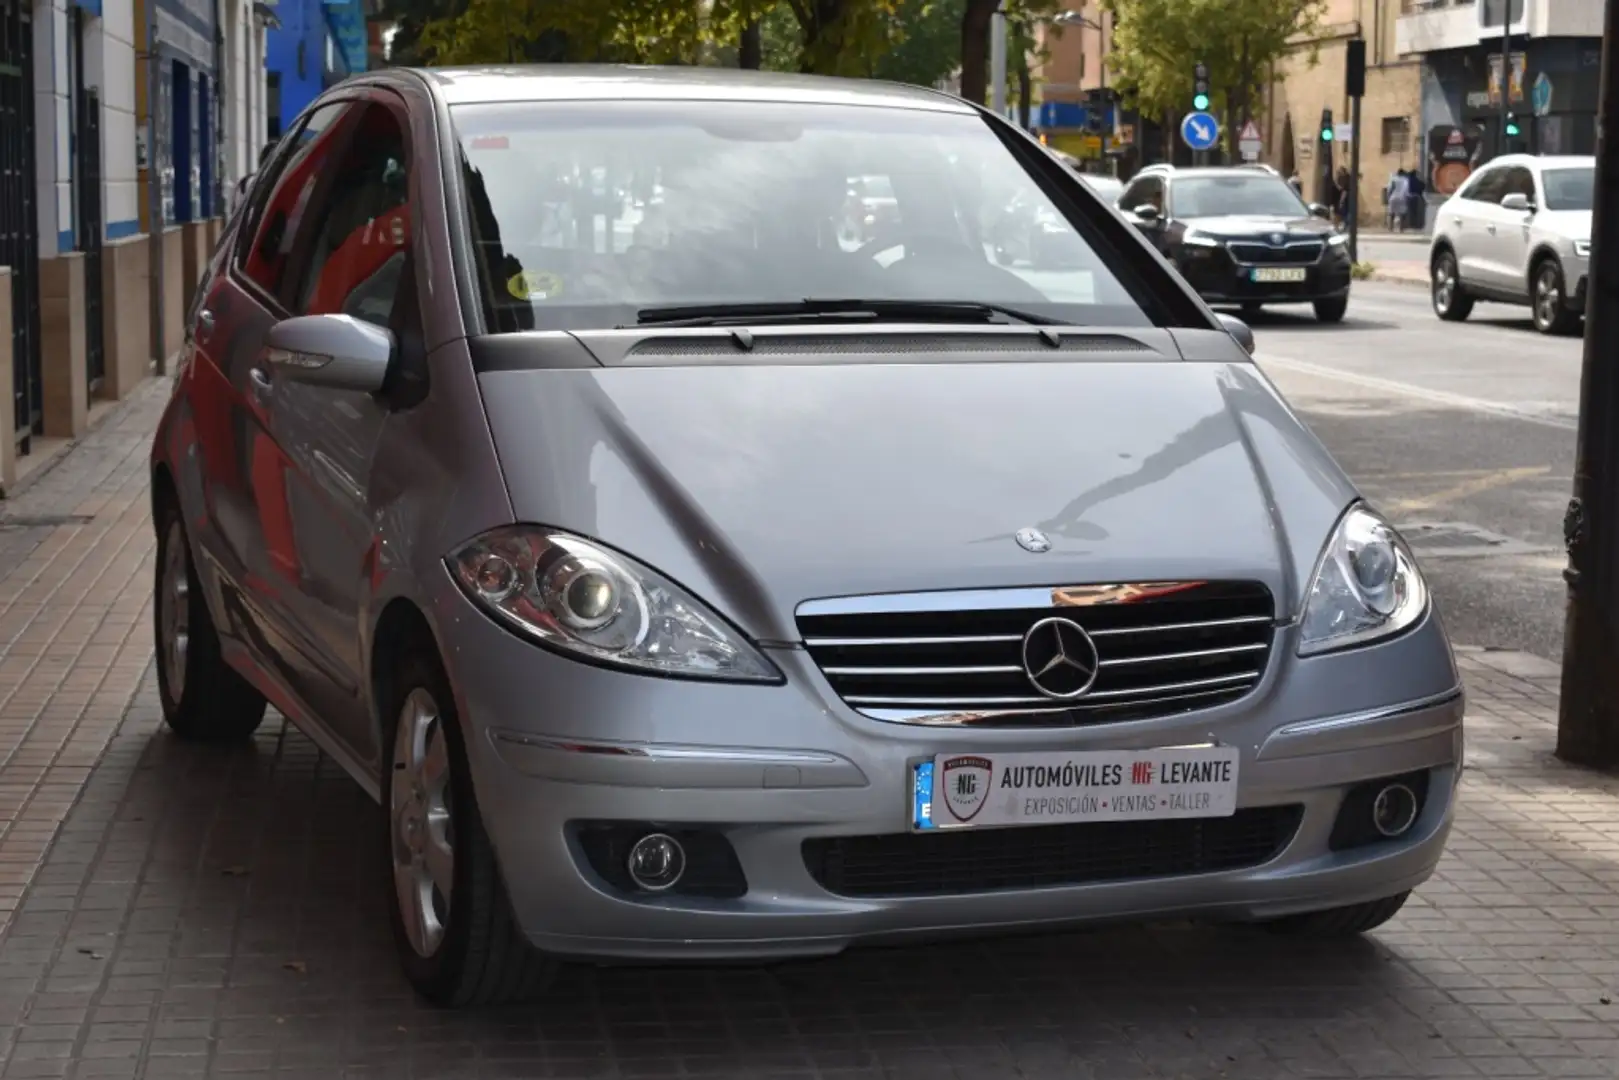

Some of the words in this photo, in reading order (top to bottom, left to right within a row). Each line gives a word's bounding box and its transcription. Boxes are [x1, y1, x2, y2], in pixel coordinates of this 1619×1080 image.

[957, 773, 977, 795] NG
[1000, 760, 1122, 788] AUTOMÓVILES
[1161, 760, 1231, 784] LEVANTE
[921, 803, 931, 819] E
[1024, 794, 1098, 816] EXPOSICIÓN
[1111, 795, 1157, 813] VENTAS
[1169, 792, 1210, 810] TALLER
